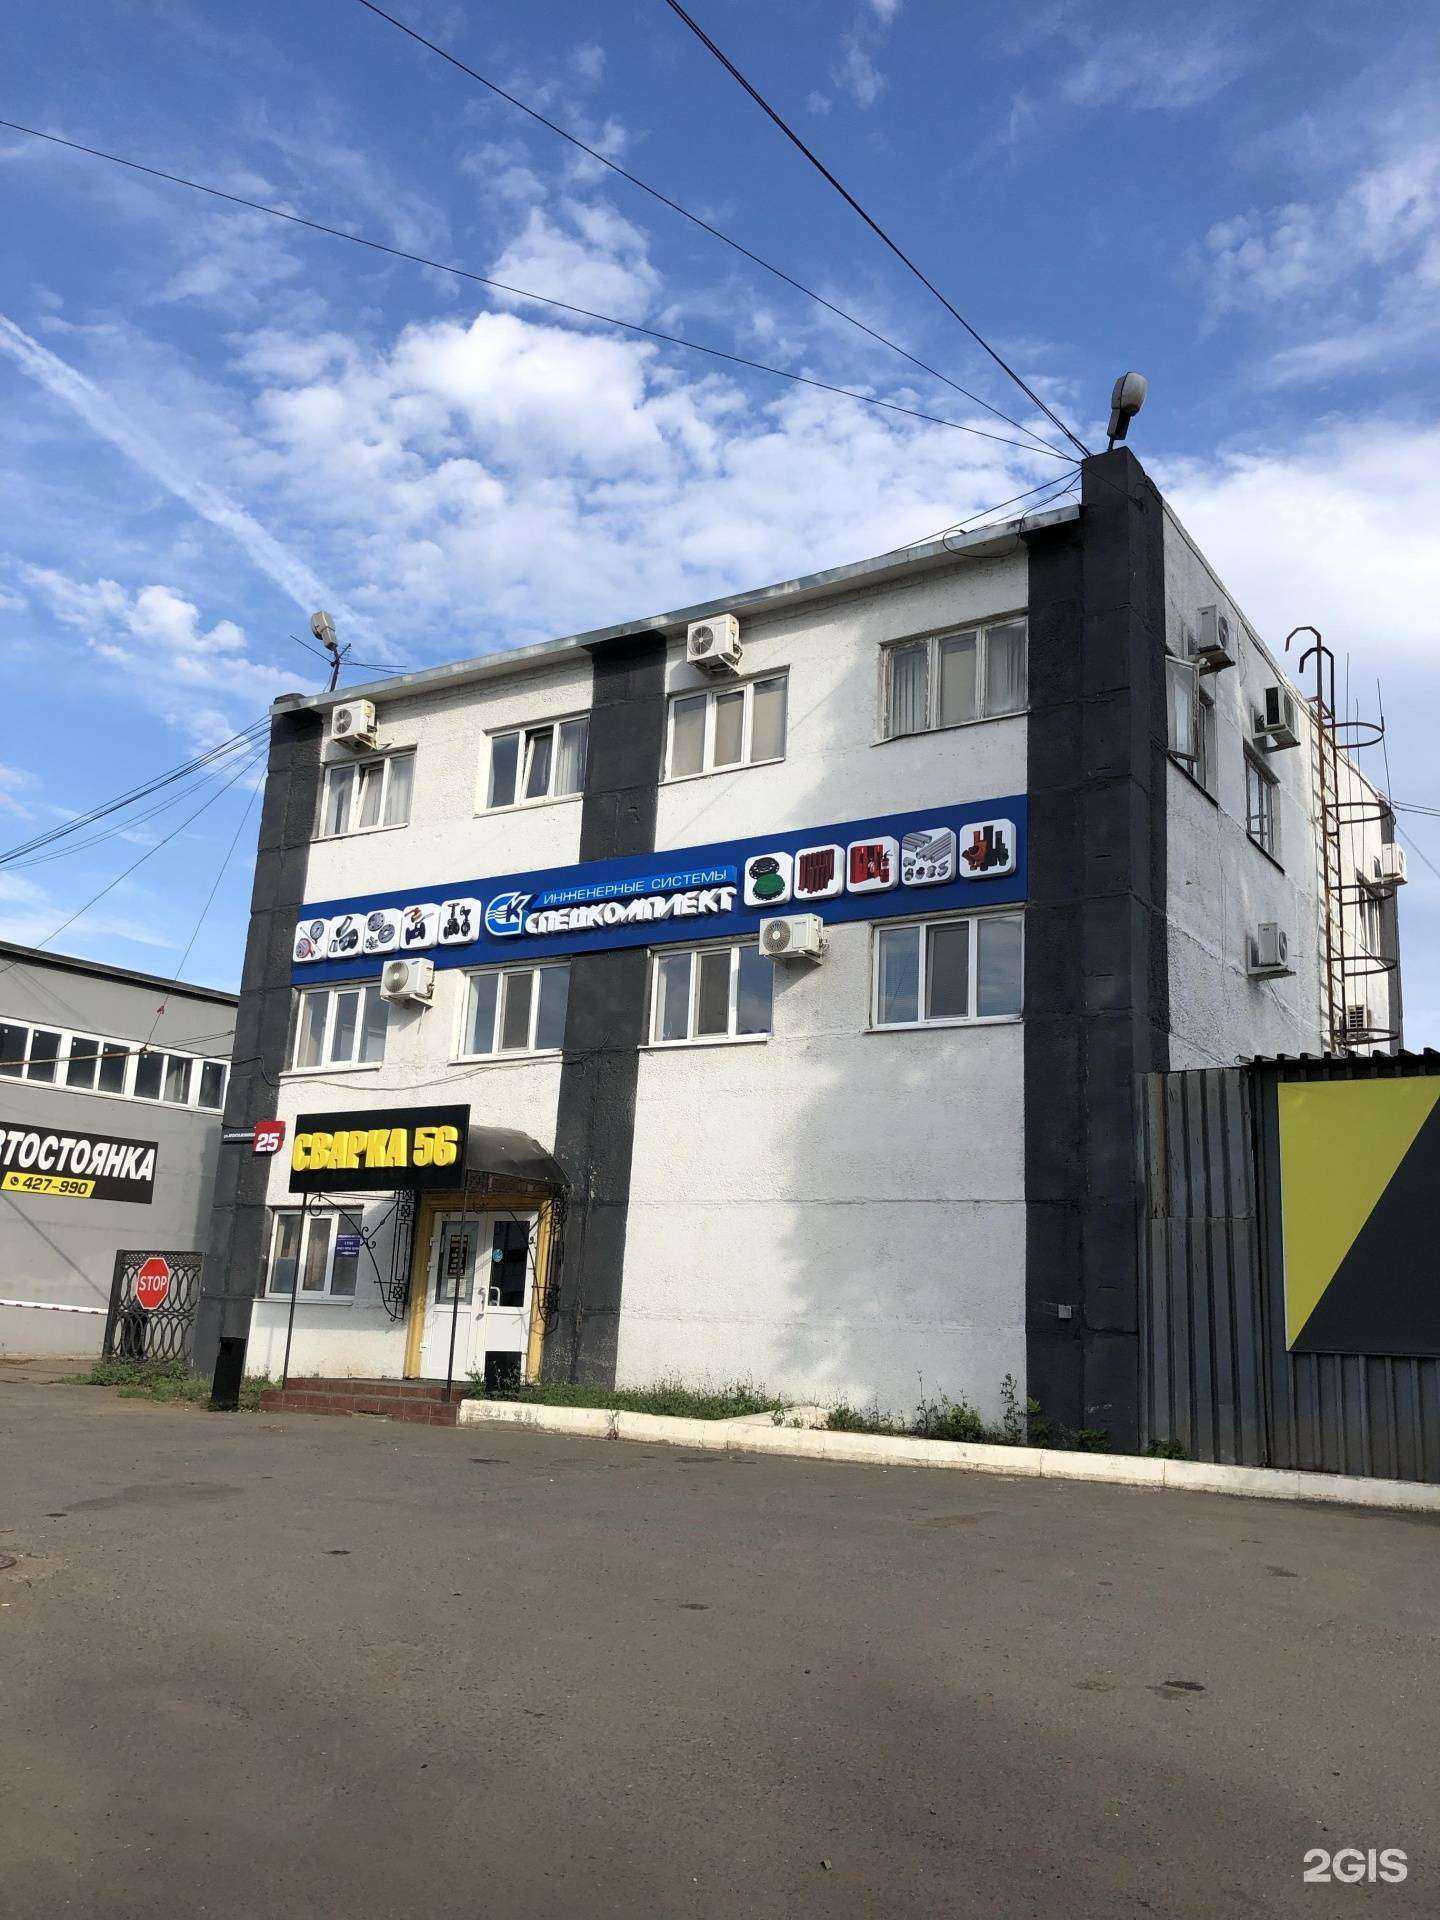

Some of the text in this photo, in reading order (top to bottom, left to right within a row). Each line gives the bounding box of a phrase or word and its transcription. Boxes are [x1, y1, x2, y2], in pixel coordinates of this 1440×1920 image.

[543, 869, 727, 904] ИНЖЕНЕРНЫЕ СИСТЕМЫ
[525, 886, 737, 934] СПЕЦКОМПЛЕКТ
[255, 1133, 280, 1152] 25
[292, 1125, 458, 1171] СВАРКА 56
[22, 1176, 88, 1195] 427-990
[138, 1275, 167, 1291] STOP
